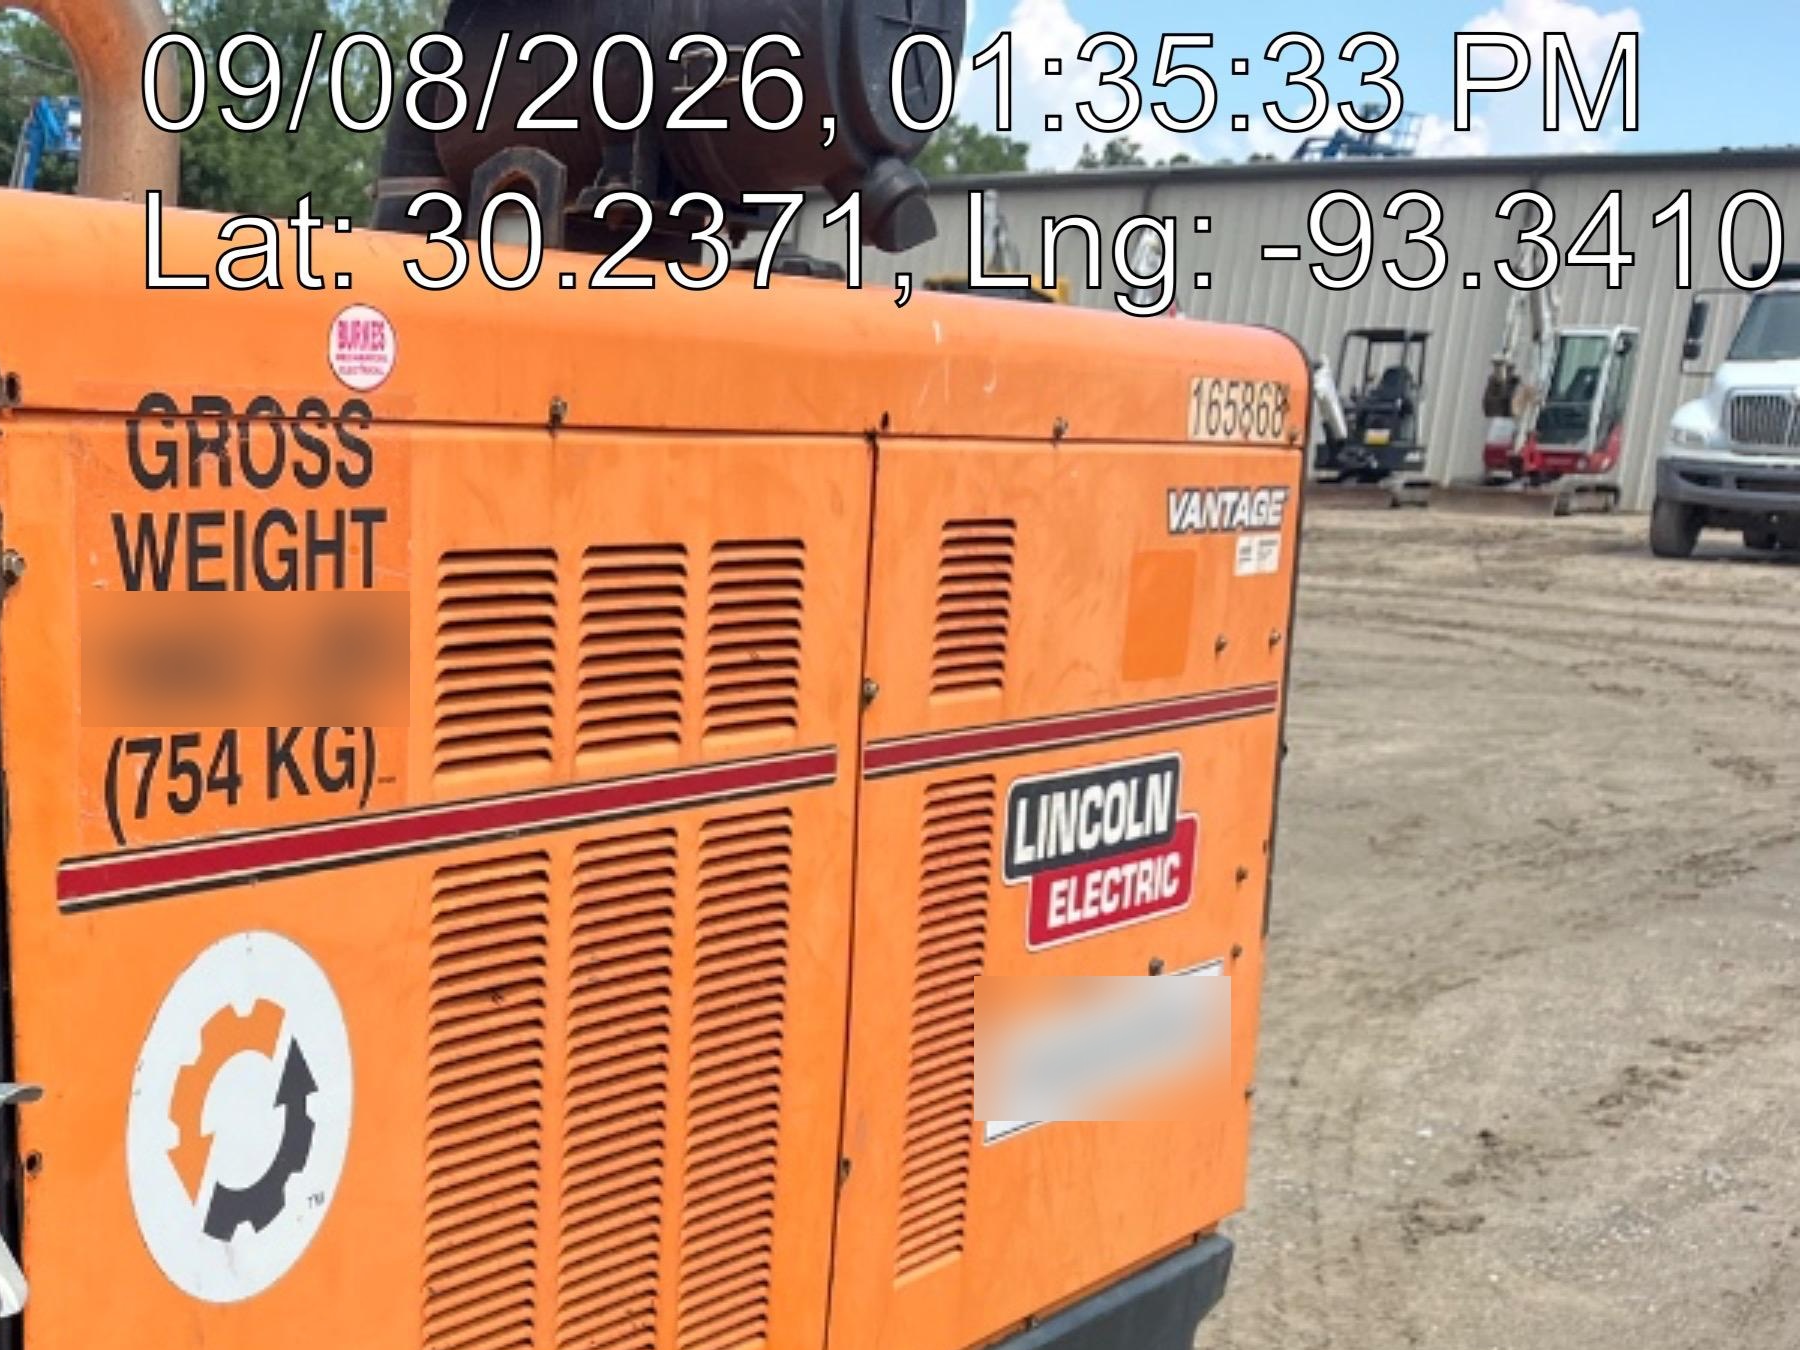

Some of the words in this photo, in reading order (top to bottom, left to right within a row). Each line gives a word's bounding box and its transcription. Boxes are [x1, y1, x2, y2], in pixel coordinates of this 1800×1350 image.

[125, 391, 374, 490] GROSS
[1193, 378, 1286, 438] 165868
[111, 508, 388, 591] WEIGHT
[1167, 486, 1288, 535] VANTAGE
[103, 727, 242, 845] (754
[266, 726, 375, 809] KG)
[1013, 770, 1174, 865] LINCOLN
[1046, 851, 1181, 930] ELECTRIC
